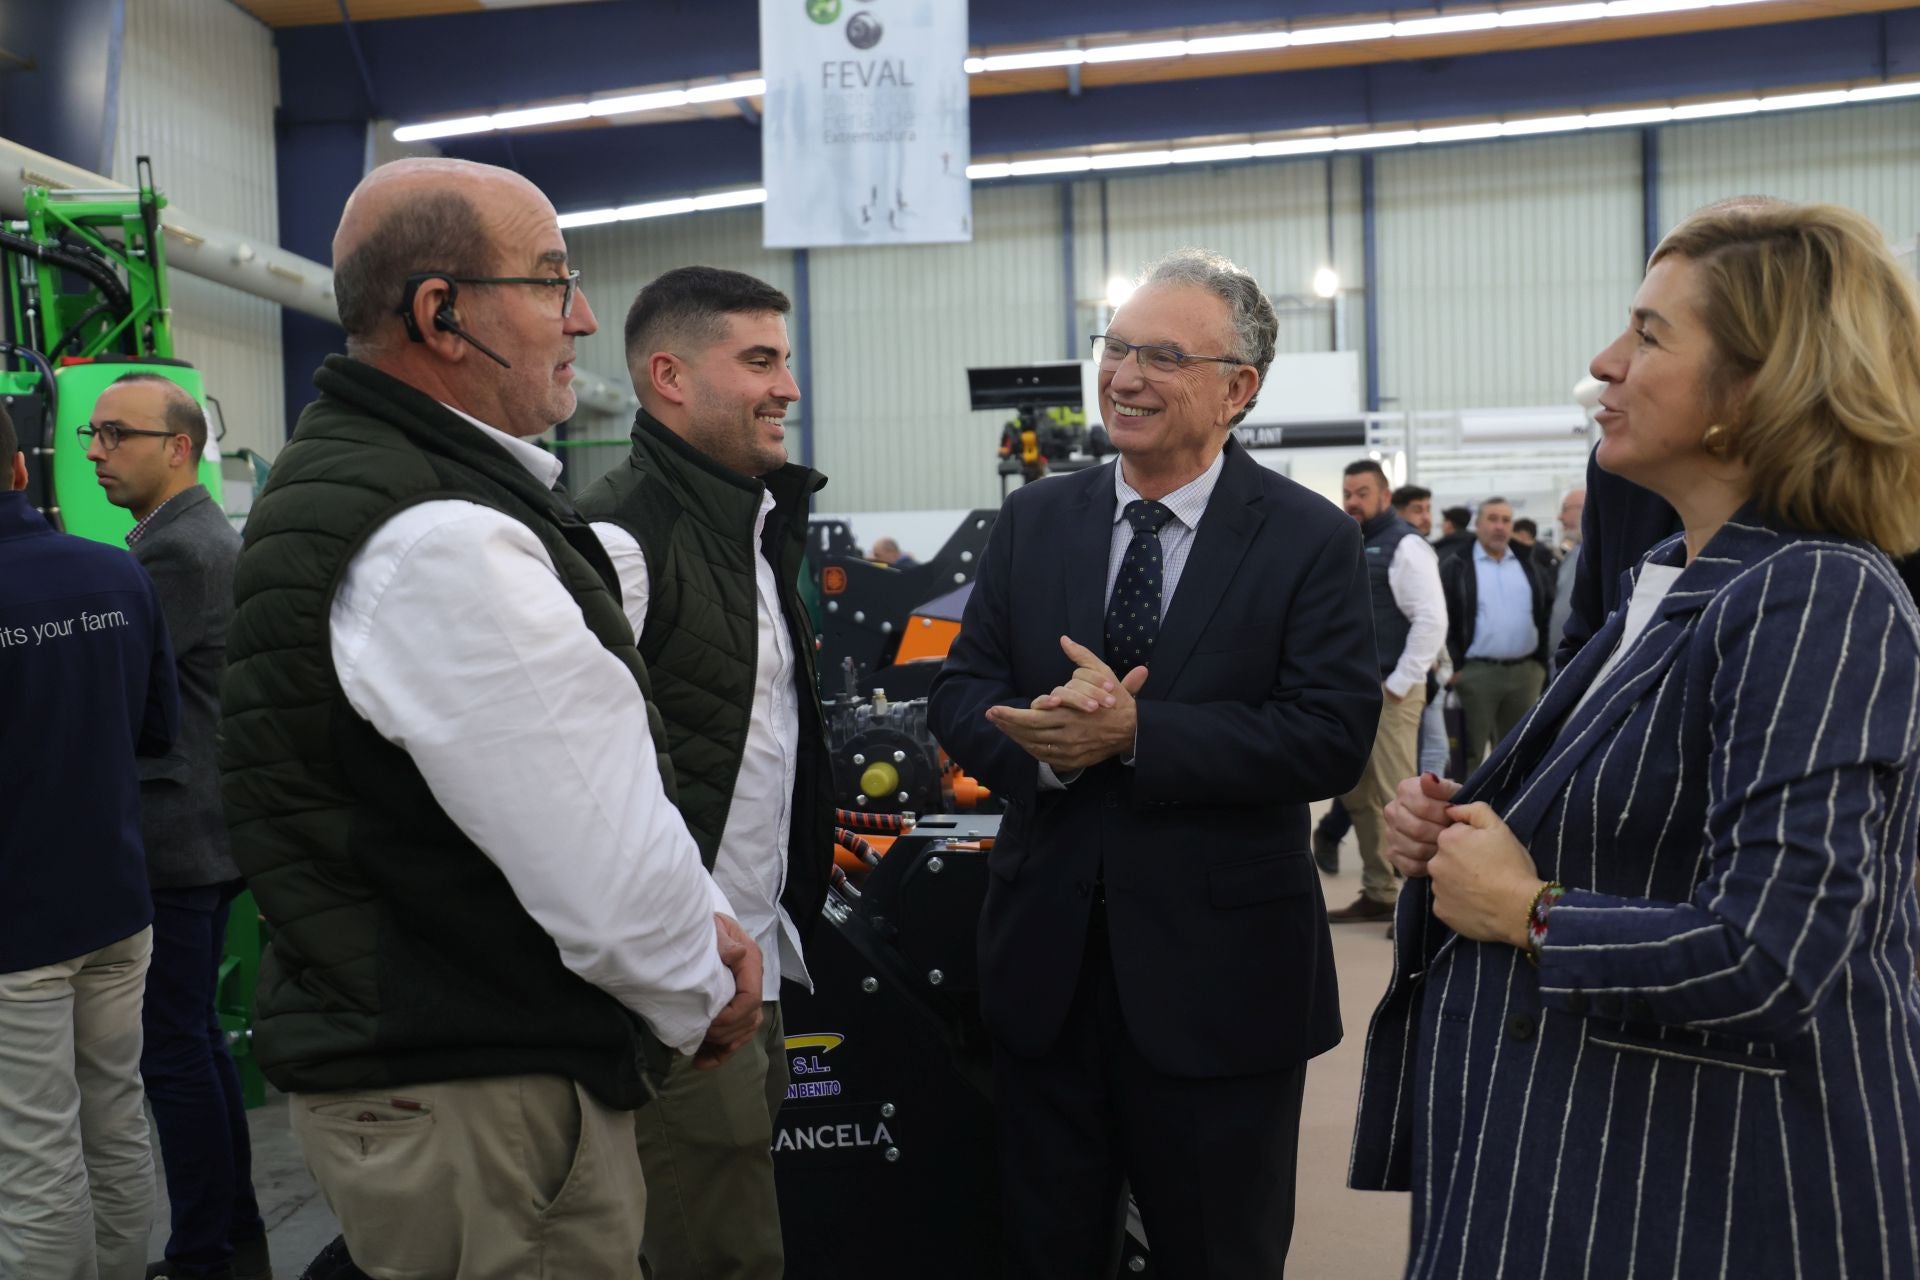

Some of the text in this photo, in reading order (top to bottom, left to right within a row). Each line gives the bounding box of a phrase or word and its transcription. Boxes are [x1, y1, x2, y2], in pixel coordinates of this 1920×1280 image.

[822, 59, 914, 88] FEVAL
[32, 618, 74, 645] your
[80, 610, 129, 632] farm.
[793, 1055, 831, 1074] S.L.
[799, 1080, 842, 1098] BENITO
[771, 1121, 894, 1152] ANCELA
